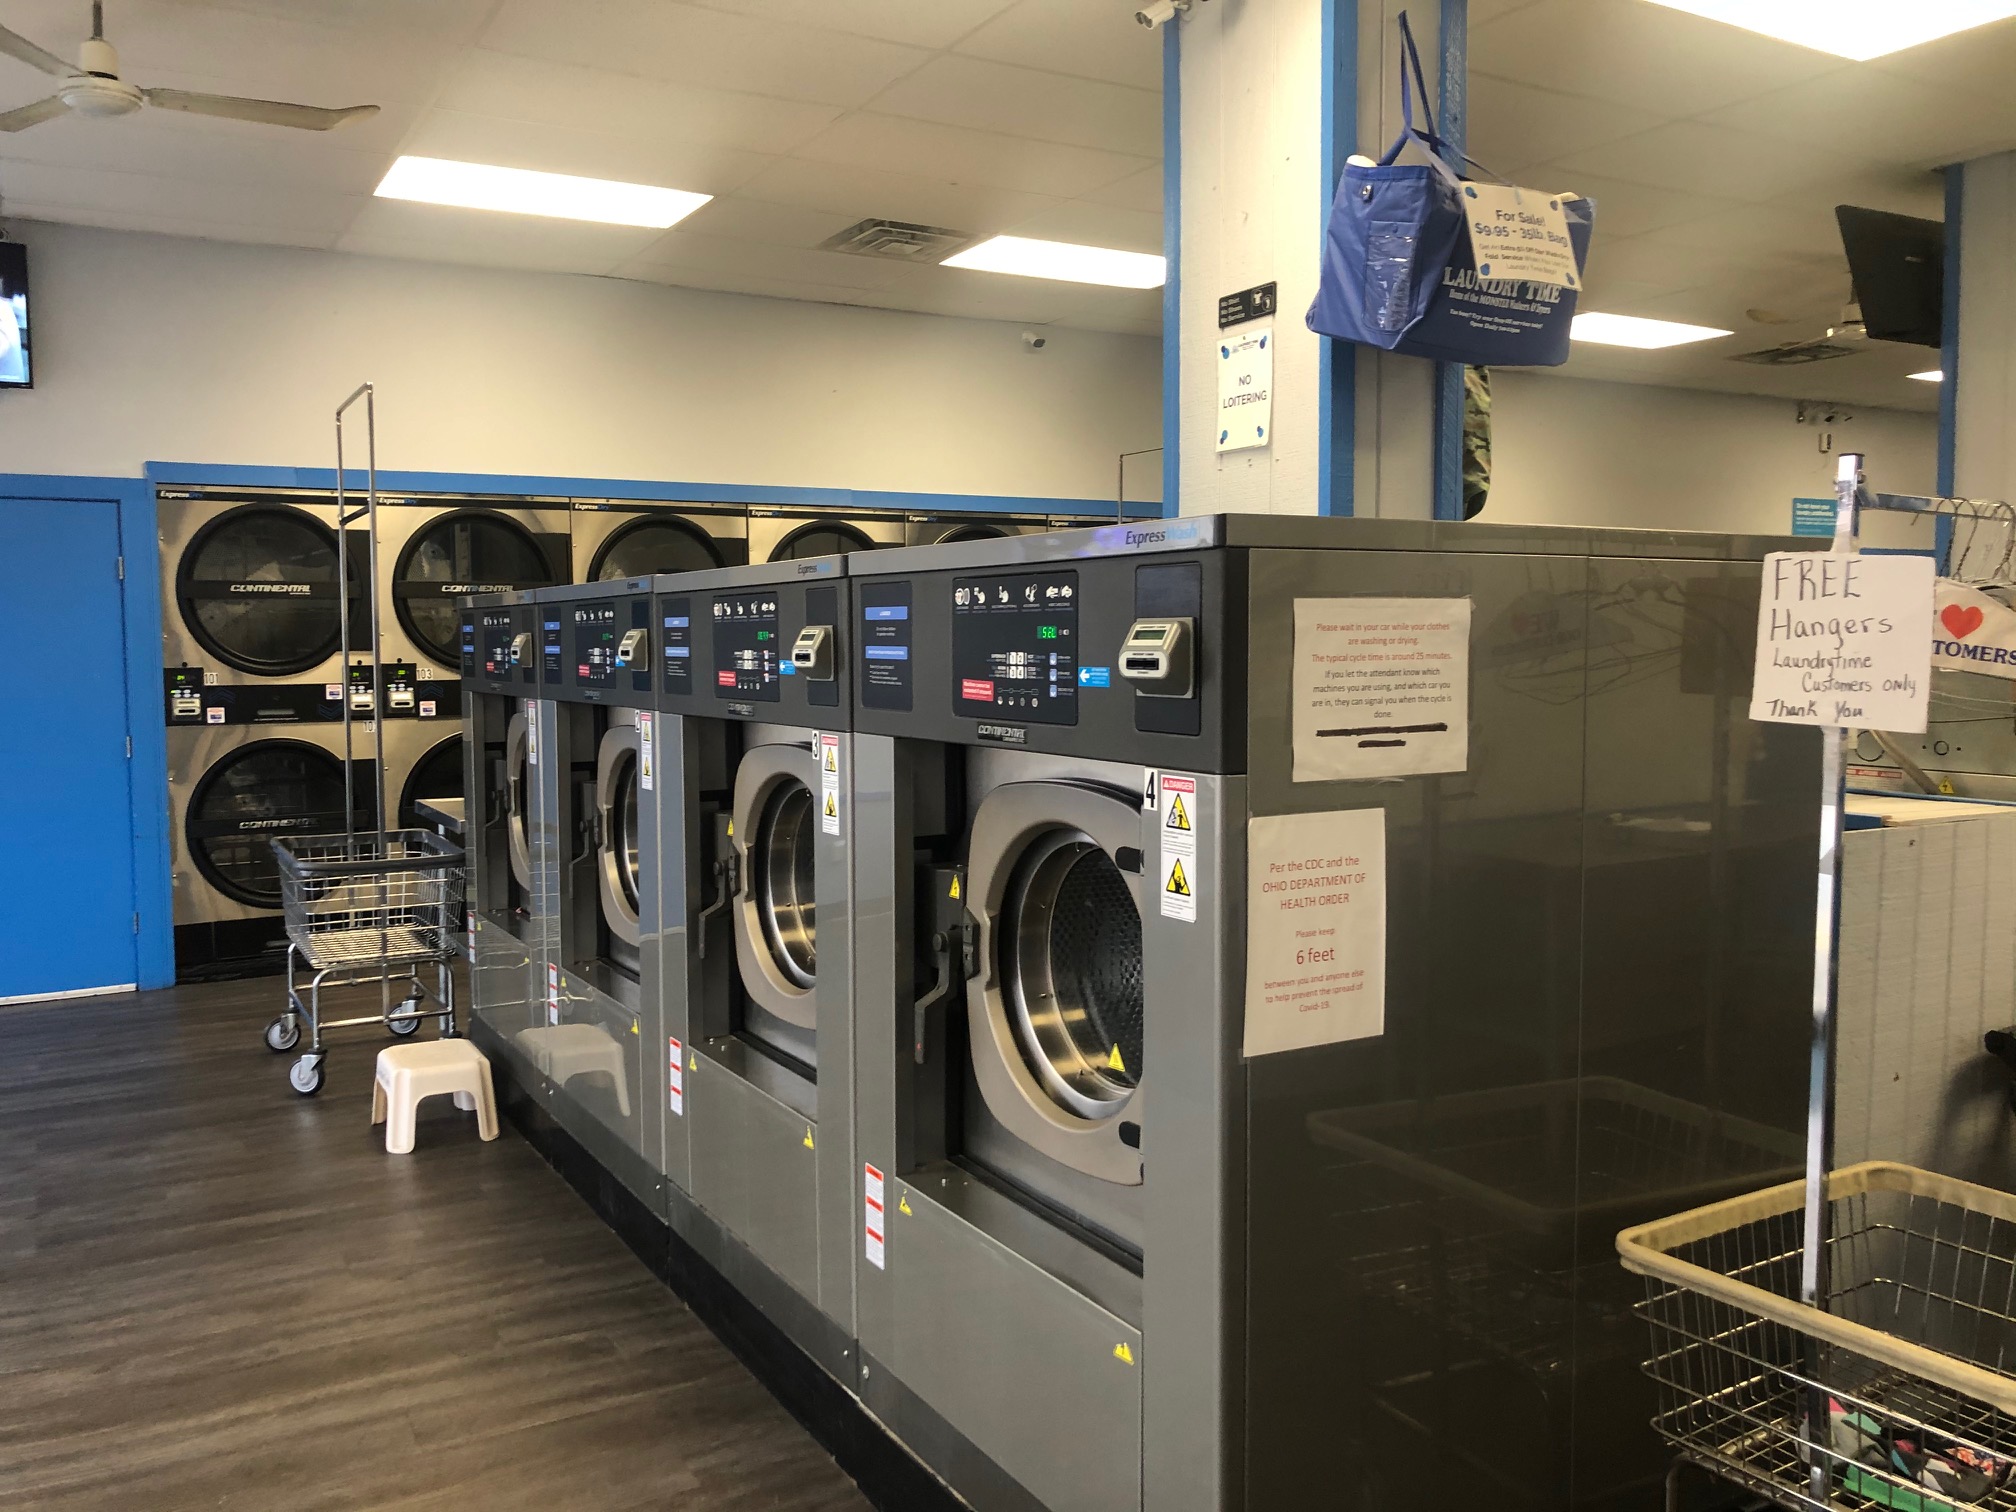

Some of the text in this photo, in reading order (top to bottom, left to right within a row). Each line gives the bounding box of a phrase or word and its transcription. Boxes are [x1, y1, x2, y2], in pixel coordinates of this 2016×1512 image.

[1496, 210, 1546, 226] For Sale!
[1474, 222, 1510, 237] $9.95
[1547, 231, 1568, 248] Bag
[1442, 266, 1521, 297] LAUNDRY
[1238, 374, 1252, 387] NO
[1223, 390, 1267, 409] LOITERING
[1774, 557, 1863, 601] FREE
[230, 584, 311, 592] CONTINENTAL
[1316, 623, 1338, 632] Please
[1363, 624, 1379, 632] your
[1392, 623, 1410, 631] while
[1410, 624, 1426, 632] your
[1427, 622, 1450, 631] clothes
[1769, 608, 1893, 650] Hangers
[1360, 637, 1388, 646] washing
[1397, 637, 1419, 646] drying.
[1312, 653, 1325, 662] The
[1326, 653, 1348, 663] typical
[1349, 653, 1366, 663] cycle
[1368, 653, 1384, 661] time
[1415, 652, 1424, 660] 25
[1932, 639, 2016, 666] TOMERS
[1772, 647, 1872, 679] Laundrytime
[204, 674, 219, 684] 101
[416, 669, 432, 679] 103
[1324, 670, 1330, 678] If
[1331, 671, 1344, 679] you
[1345, 669, 1354, 677] let
[1356, 669, 1368, 677] the
[1369, 668, 1402, 677] attendant
[1403, 668, 1420, 676] know
[1802, 671, 1872, 693] Customers
[1313, 684, 1345, 693] machines
[1347, 685, 1360, 693] you
[1373, 683, 1392, 692] using,
[1394, 682, 1406, 690] and
[1324, 699, 1333, 707] in,
[1335, 698, 1350, 707] they
[1364, 697, 1383, 706] signal
[1418, 695, 1429, 703] the
[1430, 694, 1446, 703] cycle
[1765, 699, 1863, 723] Thank You
[364, 721, 375, 731] 10
[1146, 771, 1156, 808] 4
[1270, 856, 1359, 873] Per the CDC and the
[1262, 873, 1366, 892] OHIO DEPARTMENT OF
[1280, 893, 1350, 910] HEALTH ORDER
[1296, 928, 1335, 938] Please keep
[1296, 947, 1335, 965] 6 feet
[1264, 969, 1364, 989] between you and anyone else
[1275, 994, 1290, 1002] help
[1291, 989, 1318, 1001] prevent
[1332, 984, 1355, 994] spread
[1356, 982, 1364, 990] of
